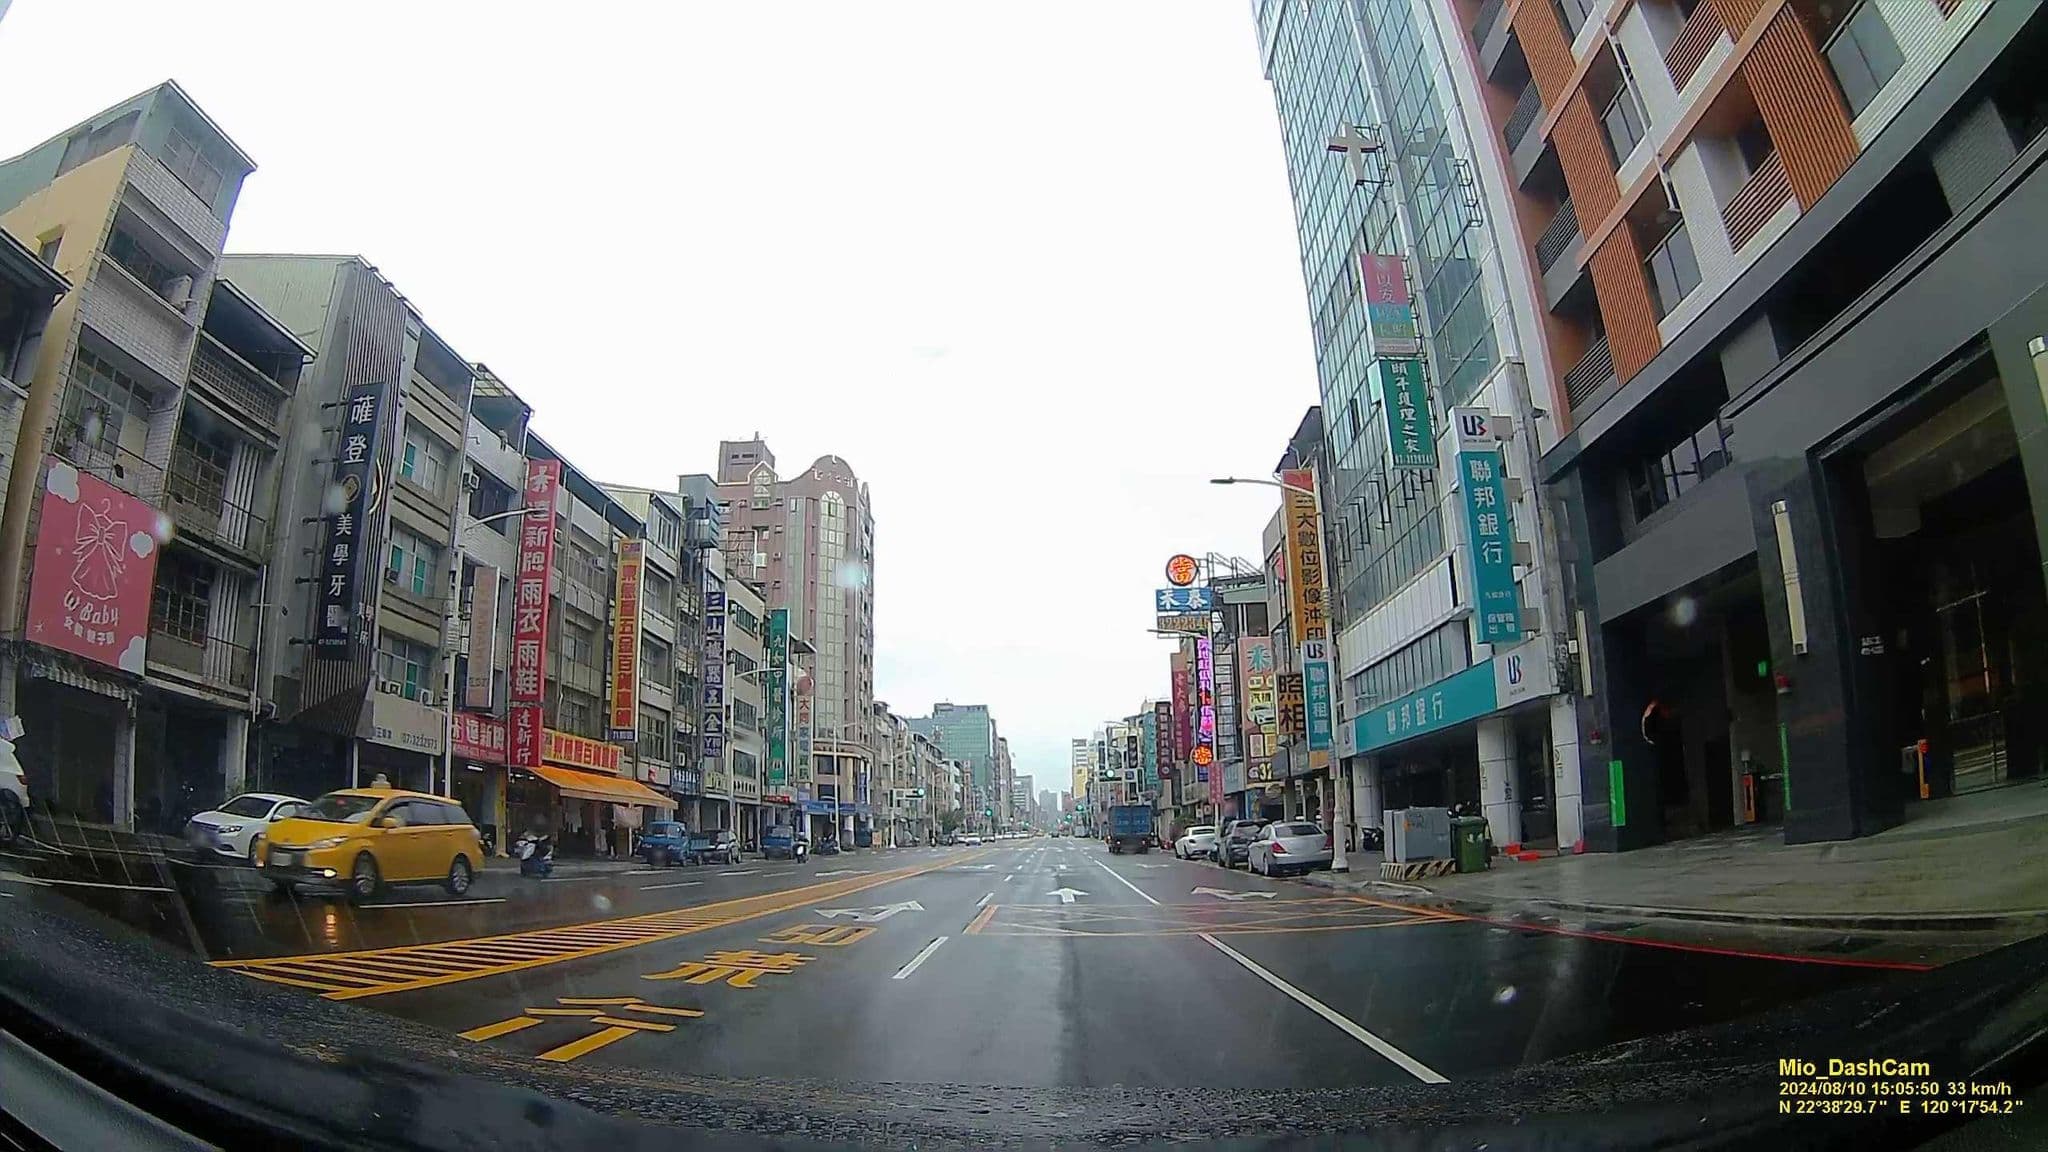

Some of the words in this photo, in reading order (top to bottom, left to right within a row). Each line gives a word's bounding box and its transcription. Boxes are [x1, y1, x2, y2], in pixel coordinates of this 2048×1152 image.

[1469, 459, 1504, 564] 聯邦銀行
[80, 602, 119, 627] Baby
[1386, 691, 1444, 734] 聯邦銀行
